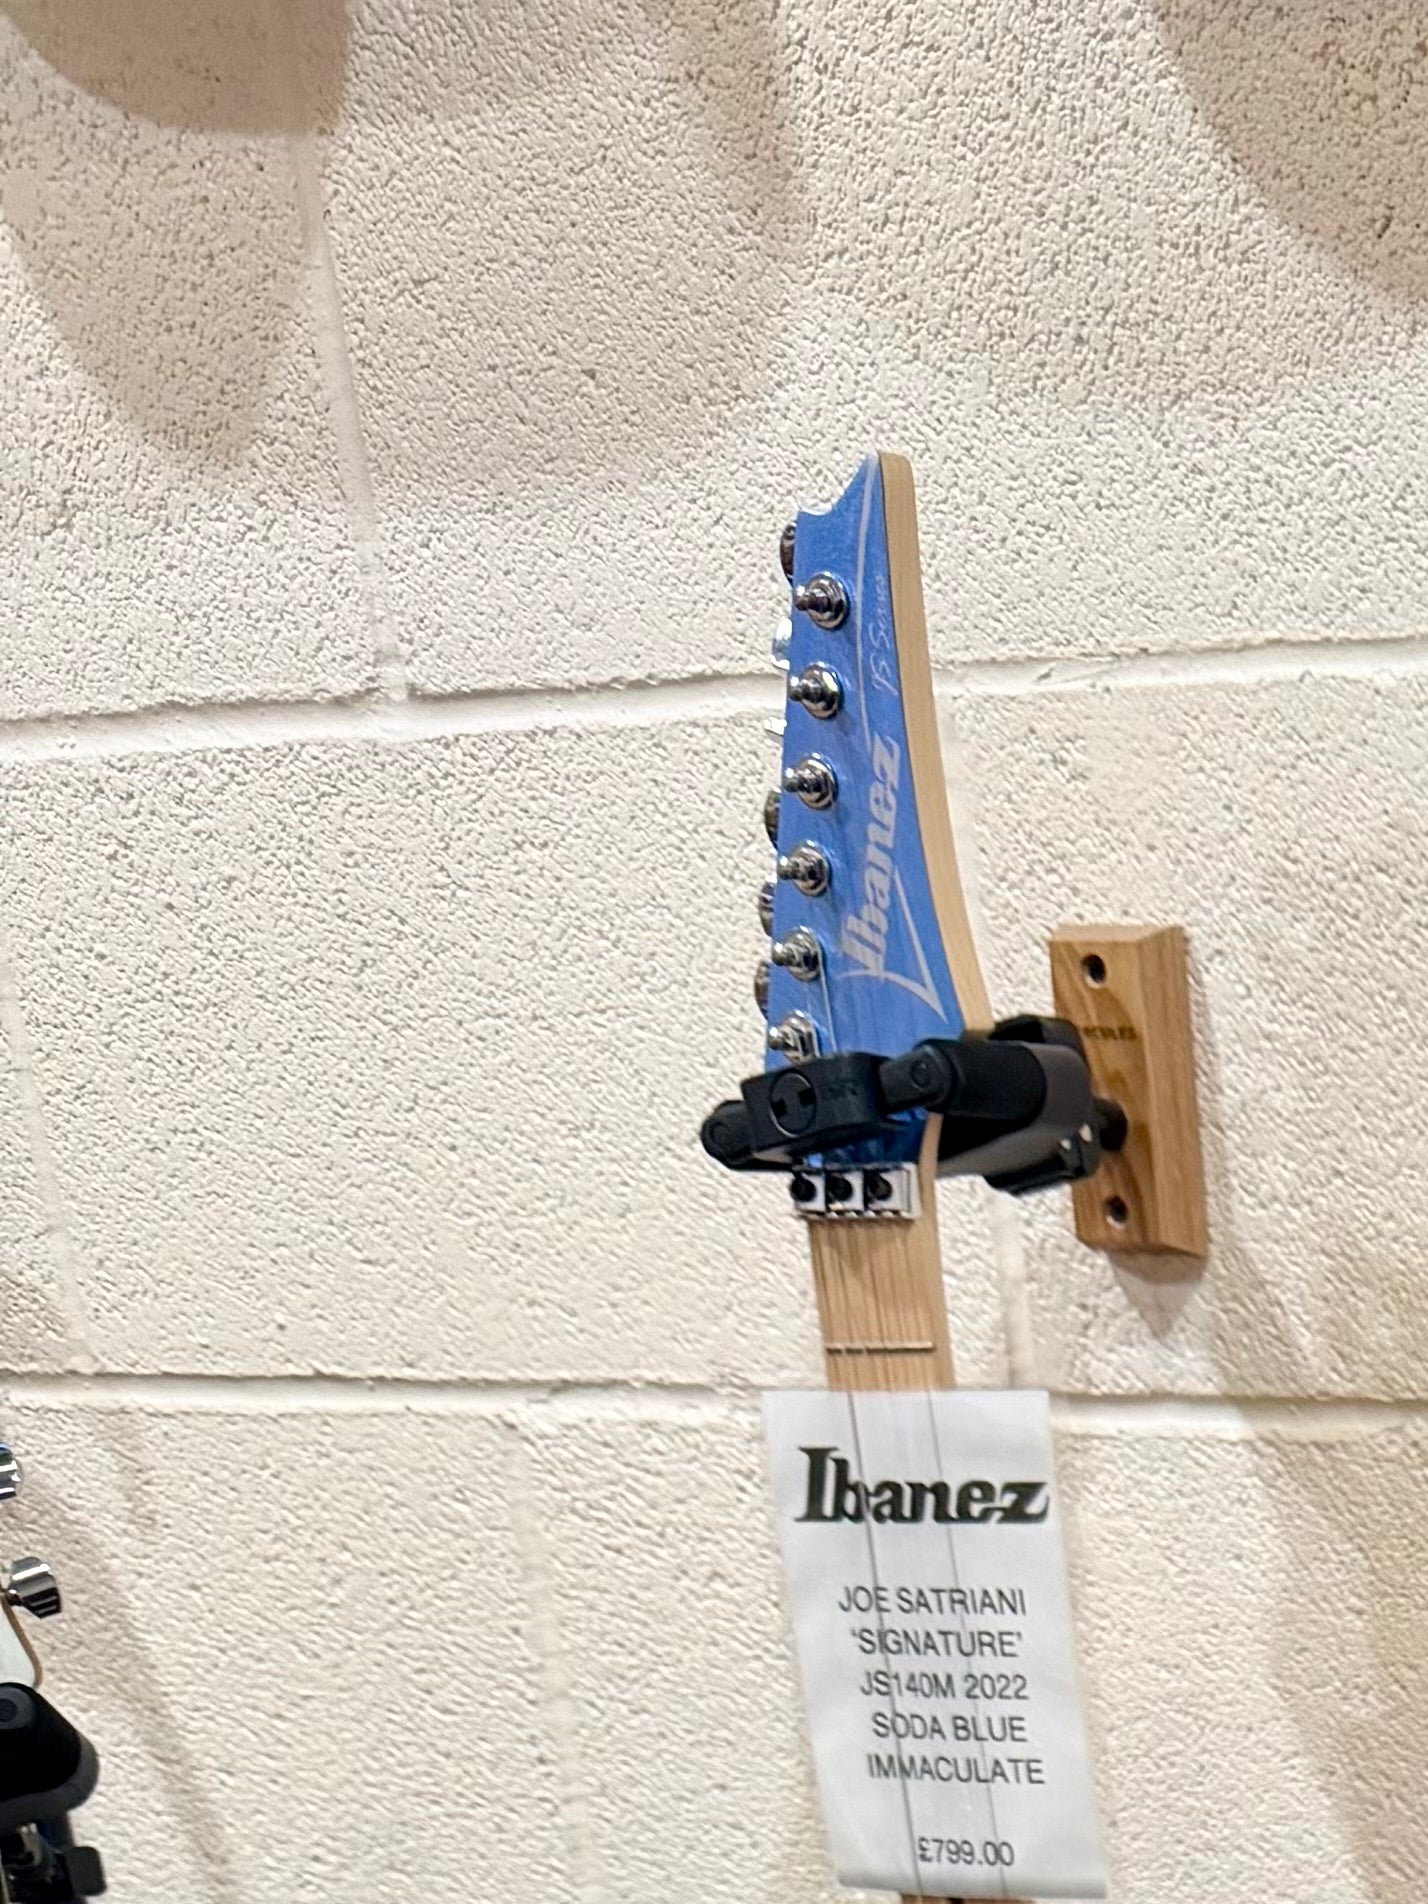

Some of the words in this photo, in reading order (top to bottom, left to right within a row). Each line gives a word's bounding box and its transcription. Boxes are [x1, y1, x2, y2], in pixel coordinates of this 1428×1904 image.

[841, 733, 900, 981] Ibanez
[795, 1446, 1049, 1524] Ibanez
[839, 1586, 888, 1614] JOE
[897, 1588, 1026, 1617] SATRIANI
[860, 1672, 956, 1700] JS140M
[964, 1673, 1028, 1701] 2022
[872, 1713, 946, 1742] SODA
[954, 1715, 1027, 1743] BLUE
[867, 1754, 1045, 1785] IMMACULATE
[918, 1837, 1014, 1867] £799.00
